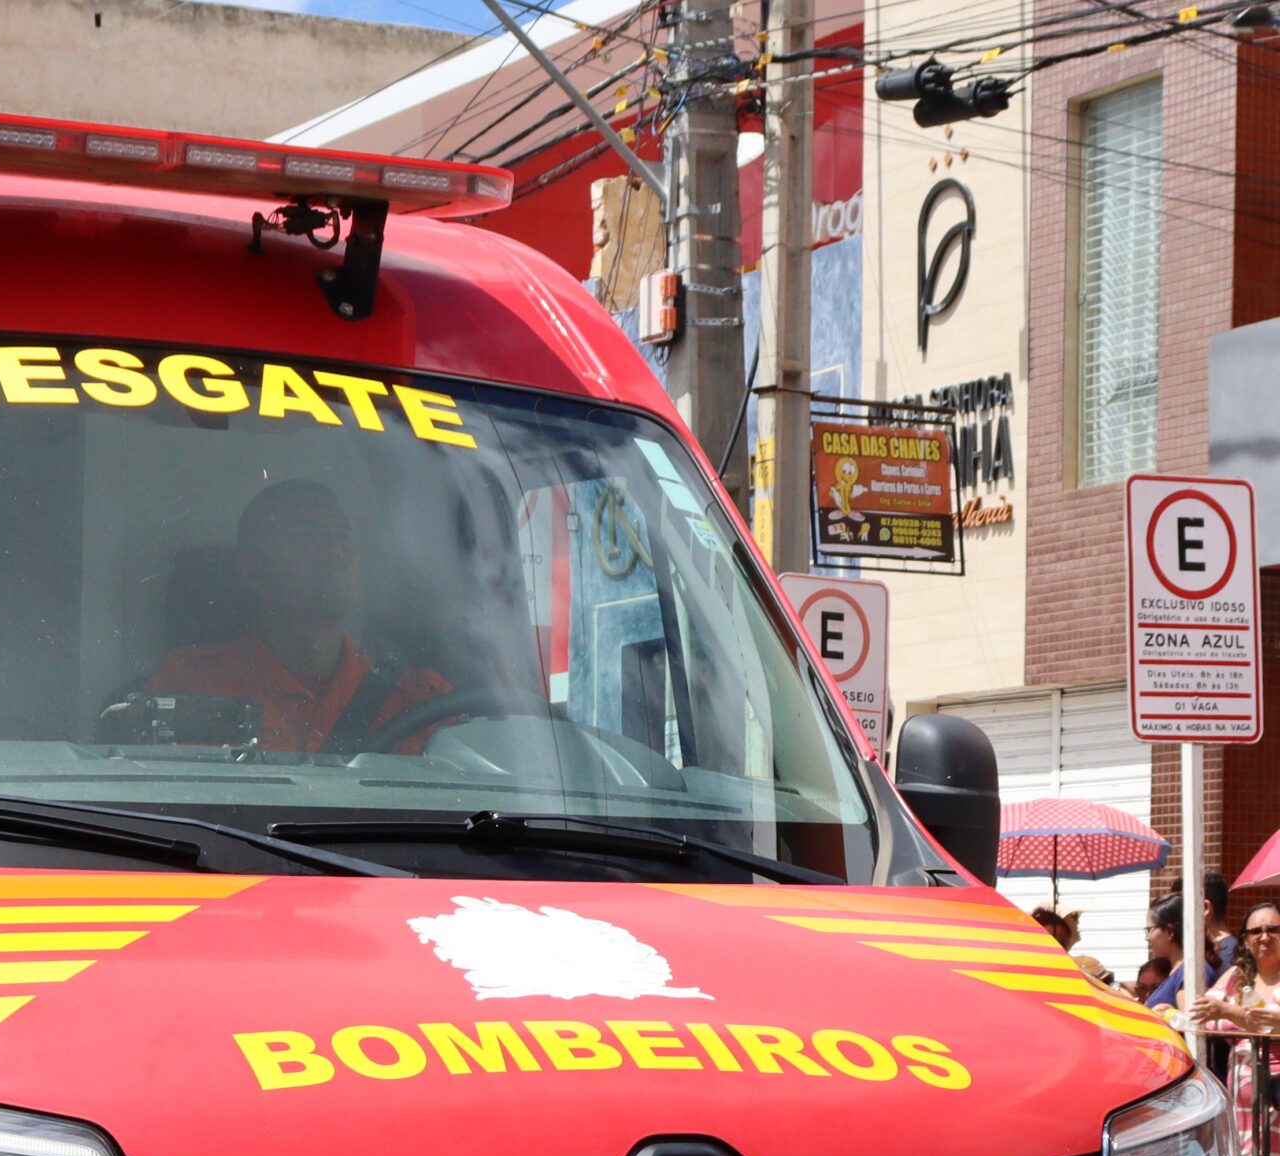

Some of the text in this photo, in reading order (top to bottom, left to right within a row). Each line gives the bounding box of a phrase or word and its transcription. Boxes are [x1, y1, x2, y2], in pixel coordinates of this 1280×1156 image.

[811, 191, 863, 242] rog
[822, 431, 941, 461] CASA DAS CHAVES
[1177, 516, 1206, 572] E
[1141, 598, 1246, 613] EXCLUSIVO IDOSO
[820, 610, 845, 660] E
[1144, 632, 1245, 649] ZONA AZUL
[1147, 669, 1166, 678] Dias
[1191, 702, 1219, 712] VAGA
[857, 718, 876, 730] GO
[1186, 723, 1212, 732] HORAS
[1215, 724, 1227, 732] NA
[1230, 724, 1252, 732] VAGA
[232, 1020, 973, 1091] BOMBEIROS
